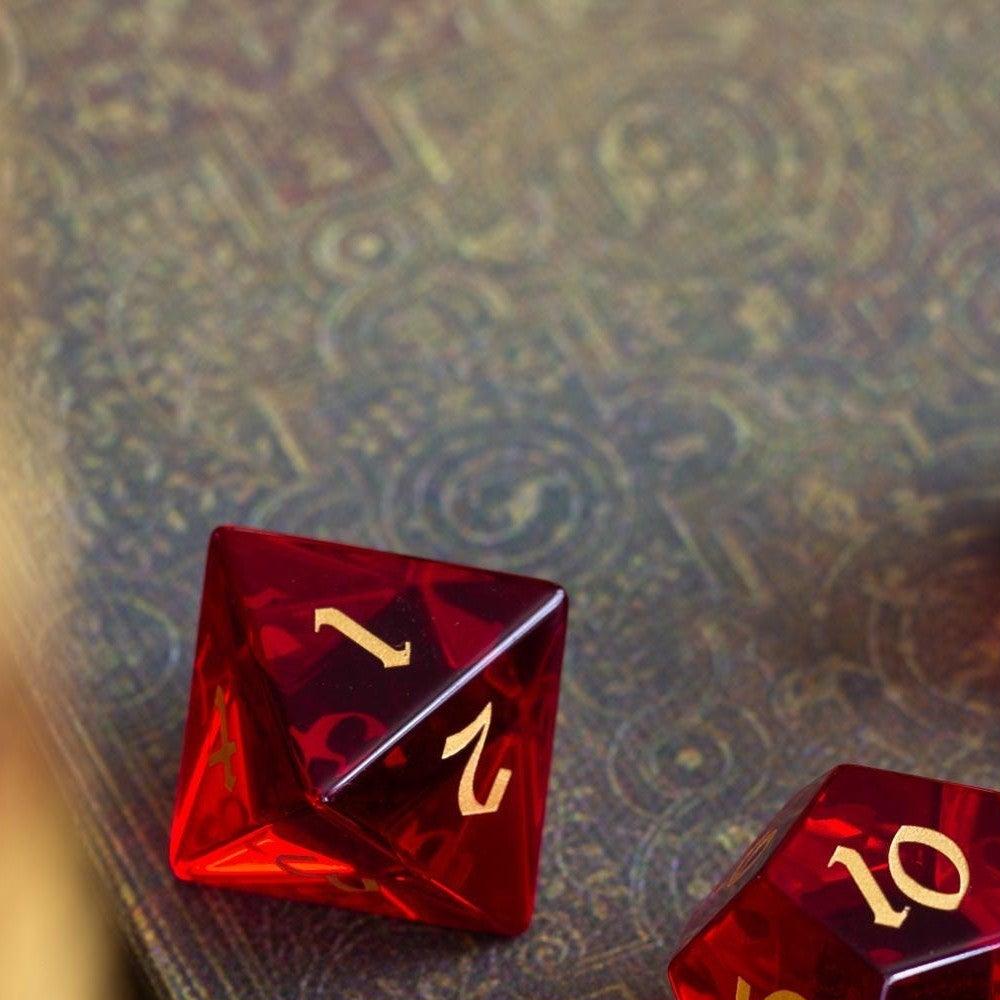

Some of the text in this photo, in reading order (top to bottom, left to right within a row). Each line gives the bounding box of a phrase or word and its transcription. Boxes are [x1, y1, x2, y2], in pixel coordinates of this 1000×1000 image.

[313, 606, 413, 669] 1
[440, 701, 513, 817] 2
[827, 824, 971, 929] 10
